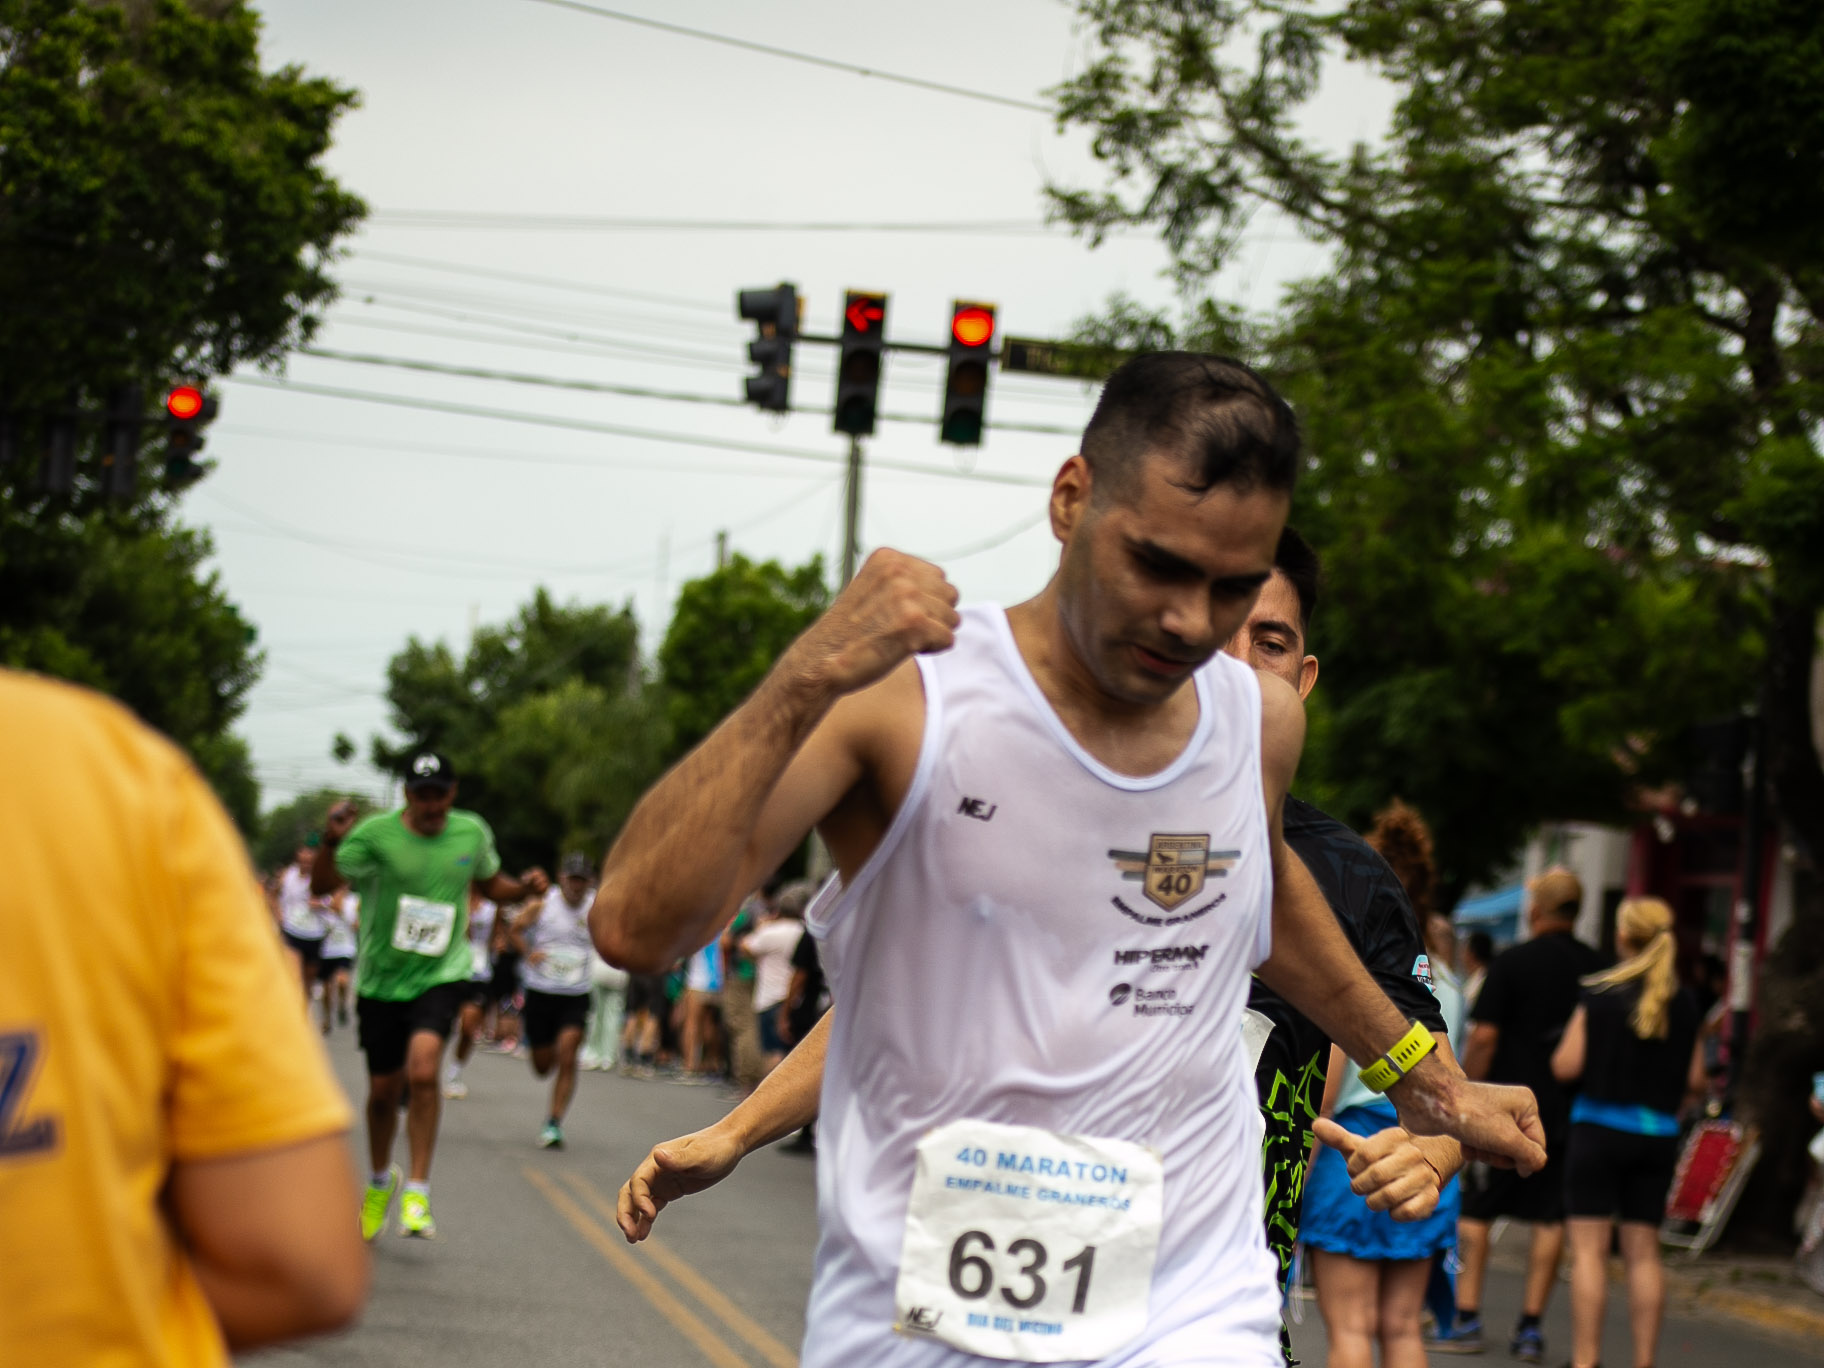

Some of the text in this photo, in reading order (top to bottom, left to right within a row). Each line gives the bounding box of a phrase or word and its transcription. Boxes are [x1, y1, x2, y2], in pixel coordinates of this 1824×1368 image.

[1156, 873, 1192, 896] 40
[956, 1148, 1128, 1185] 40 MARATON
[945, 1176, 1131, 1211] EMPALME GRANEROS
[948, 1230, 1097, 1315] 631
